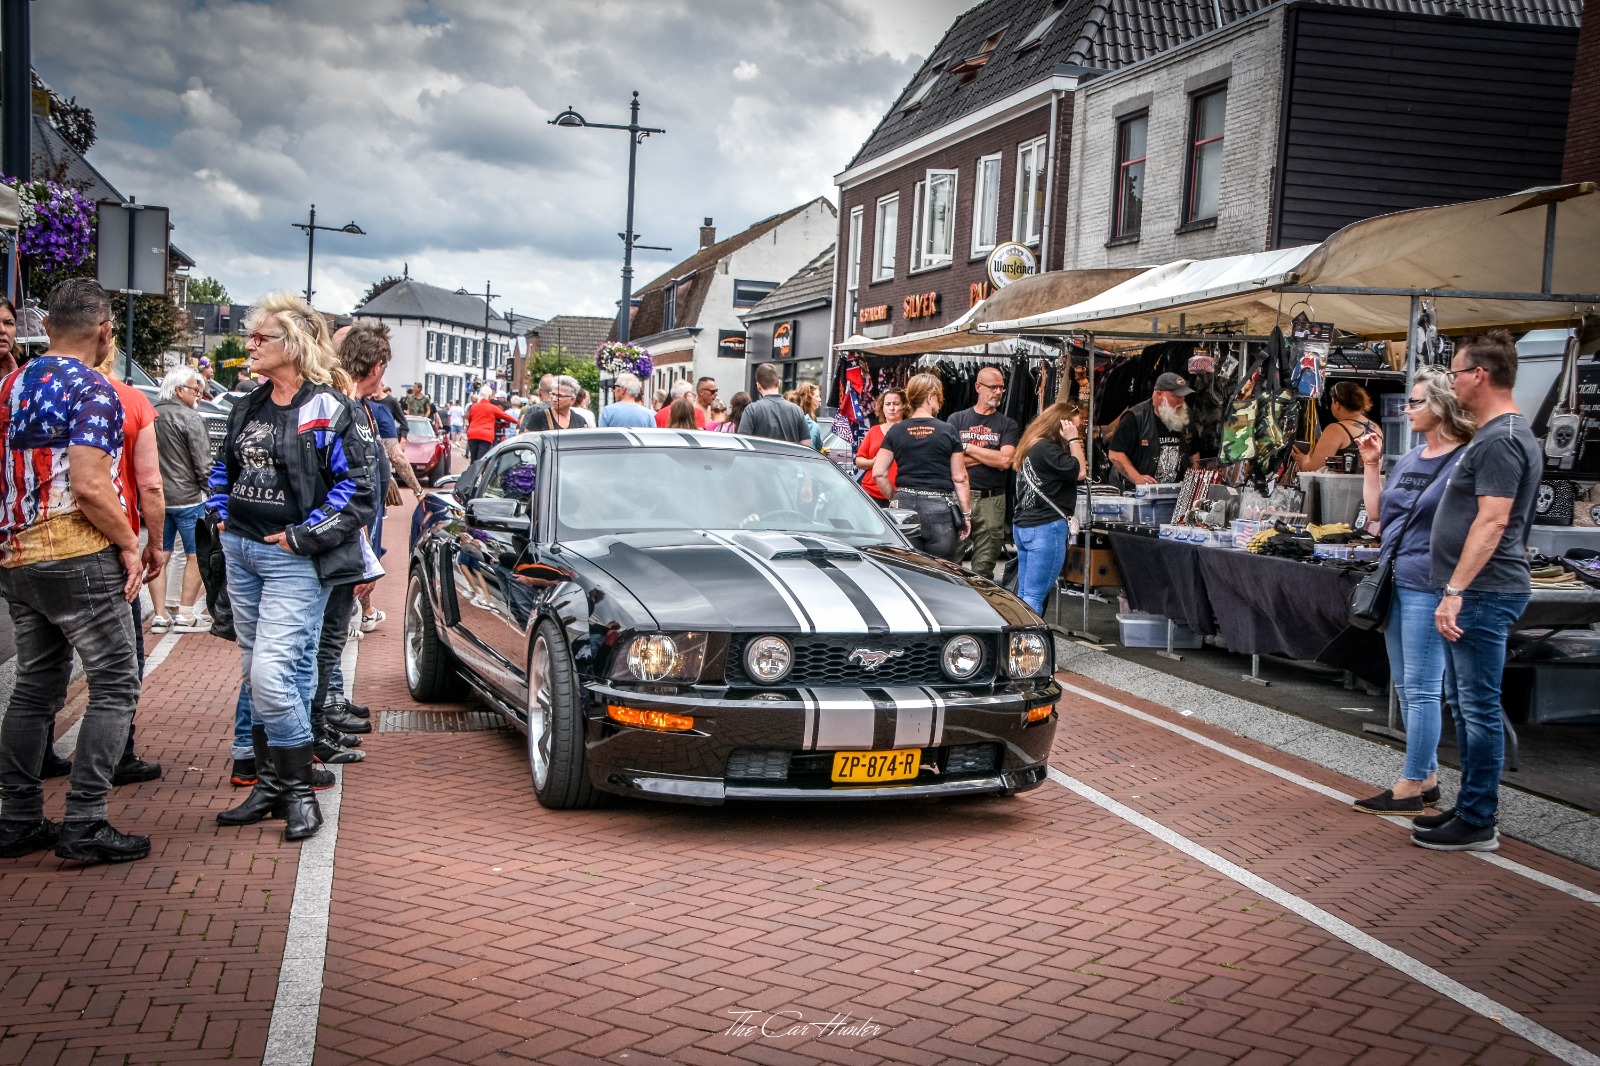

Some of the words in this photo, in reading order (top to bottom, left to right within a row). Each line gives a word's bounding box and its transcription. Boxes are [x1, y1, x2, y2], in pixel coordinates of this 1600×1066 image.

[994, 260, 1034, 276] Warsteiner
[903, 292, 936, 319] SILVER
[969, 281, 997, 308] PAL
[232, 483, 286, 501] ORSICA
[838, 753, 915, 777] ZP-874-R
